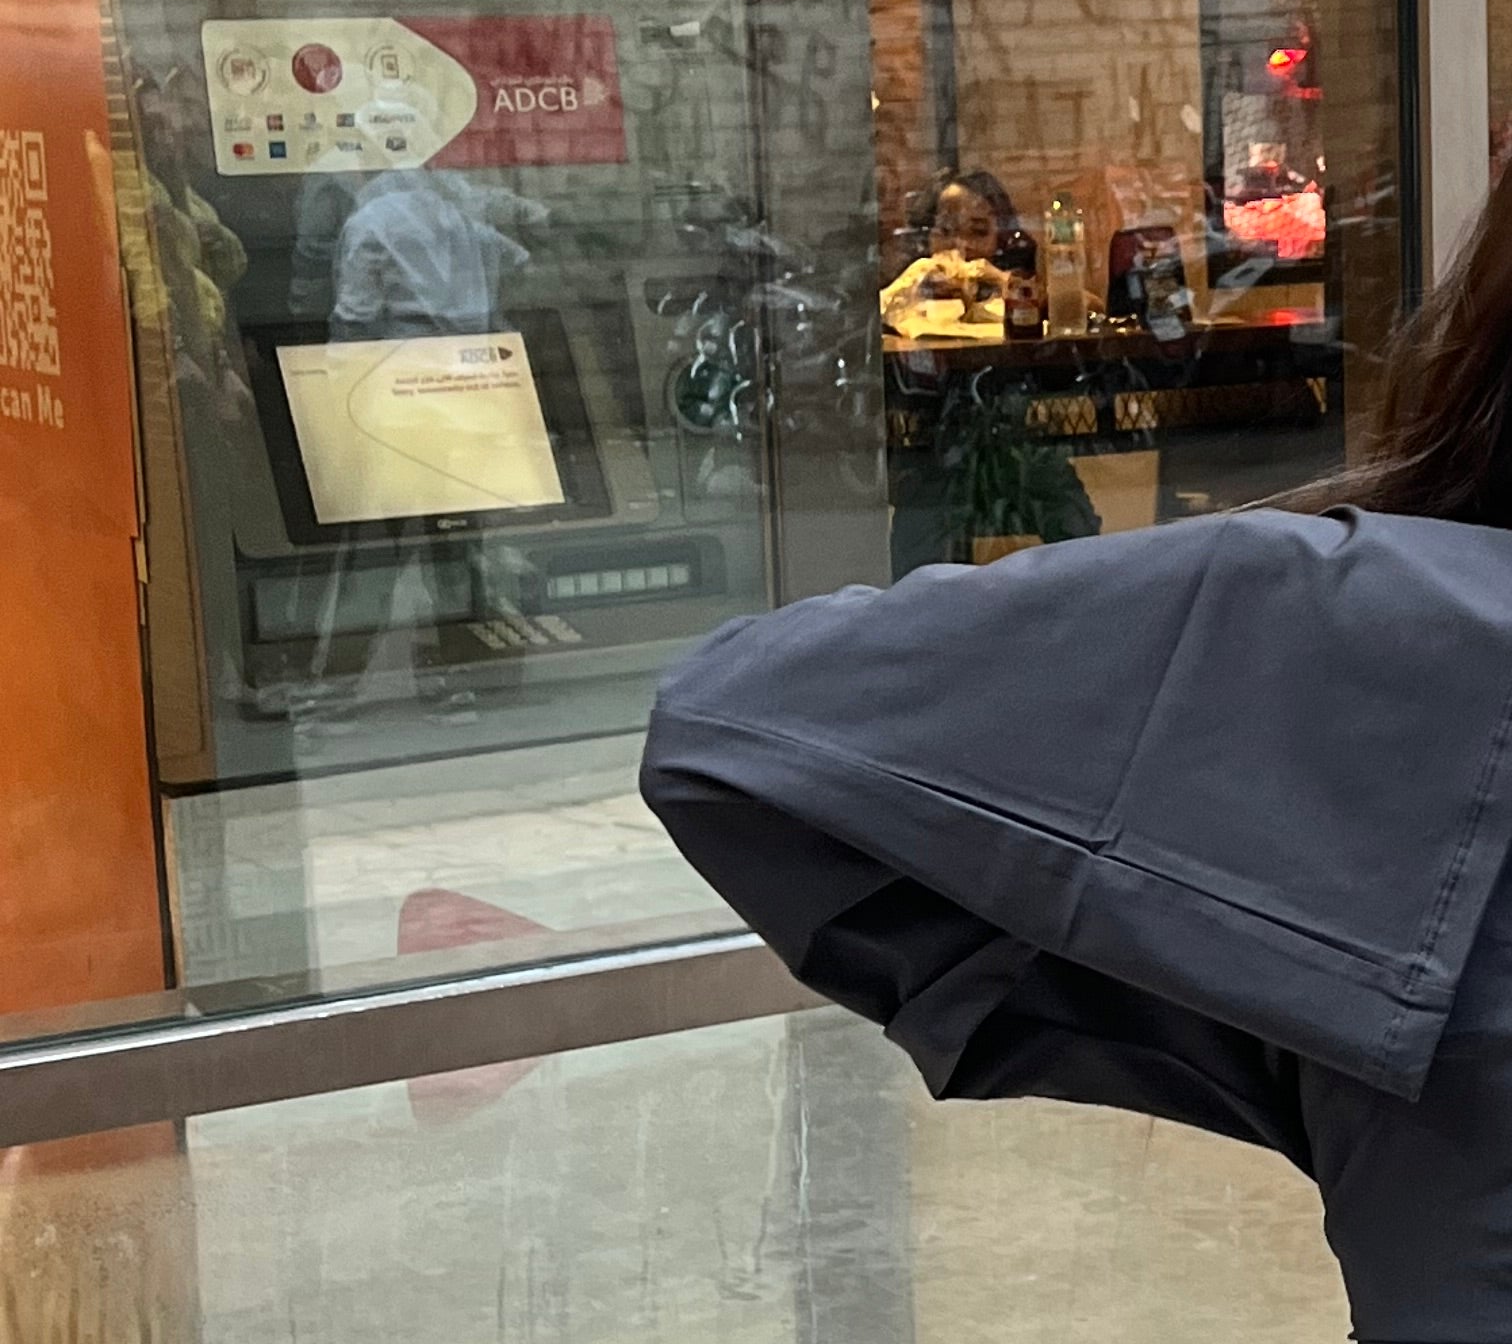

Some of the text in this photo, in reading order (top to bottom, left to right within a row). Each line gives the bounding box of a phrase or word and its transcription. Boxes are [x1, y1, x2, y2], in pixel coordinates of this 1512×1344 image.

[493, 86, 579, 113] ADCB
[0, 383, 65, 429] can Me
